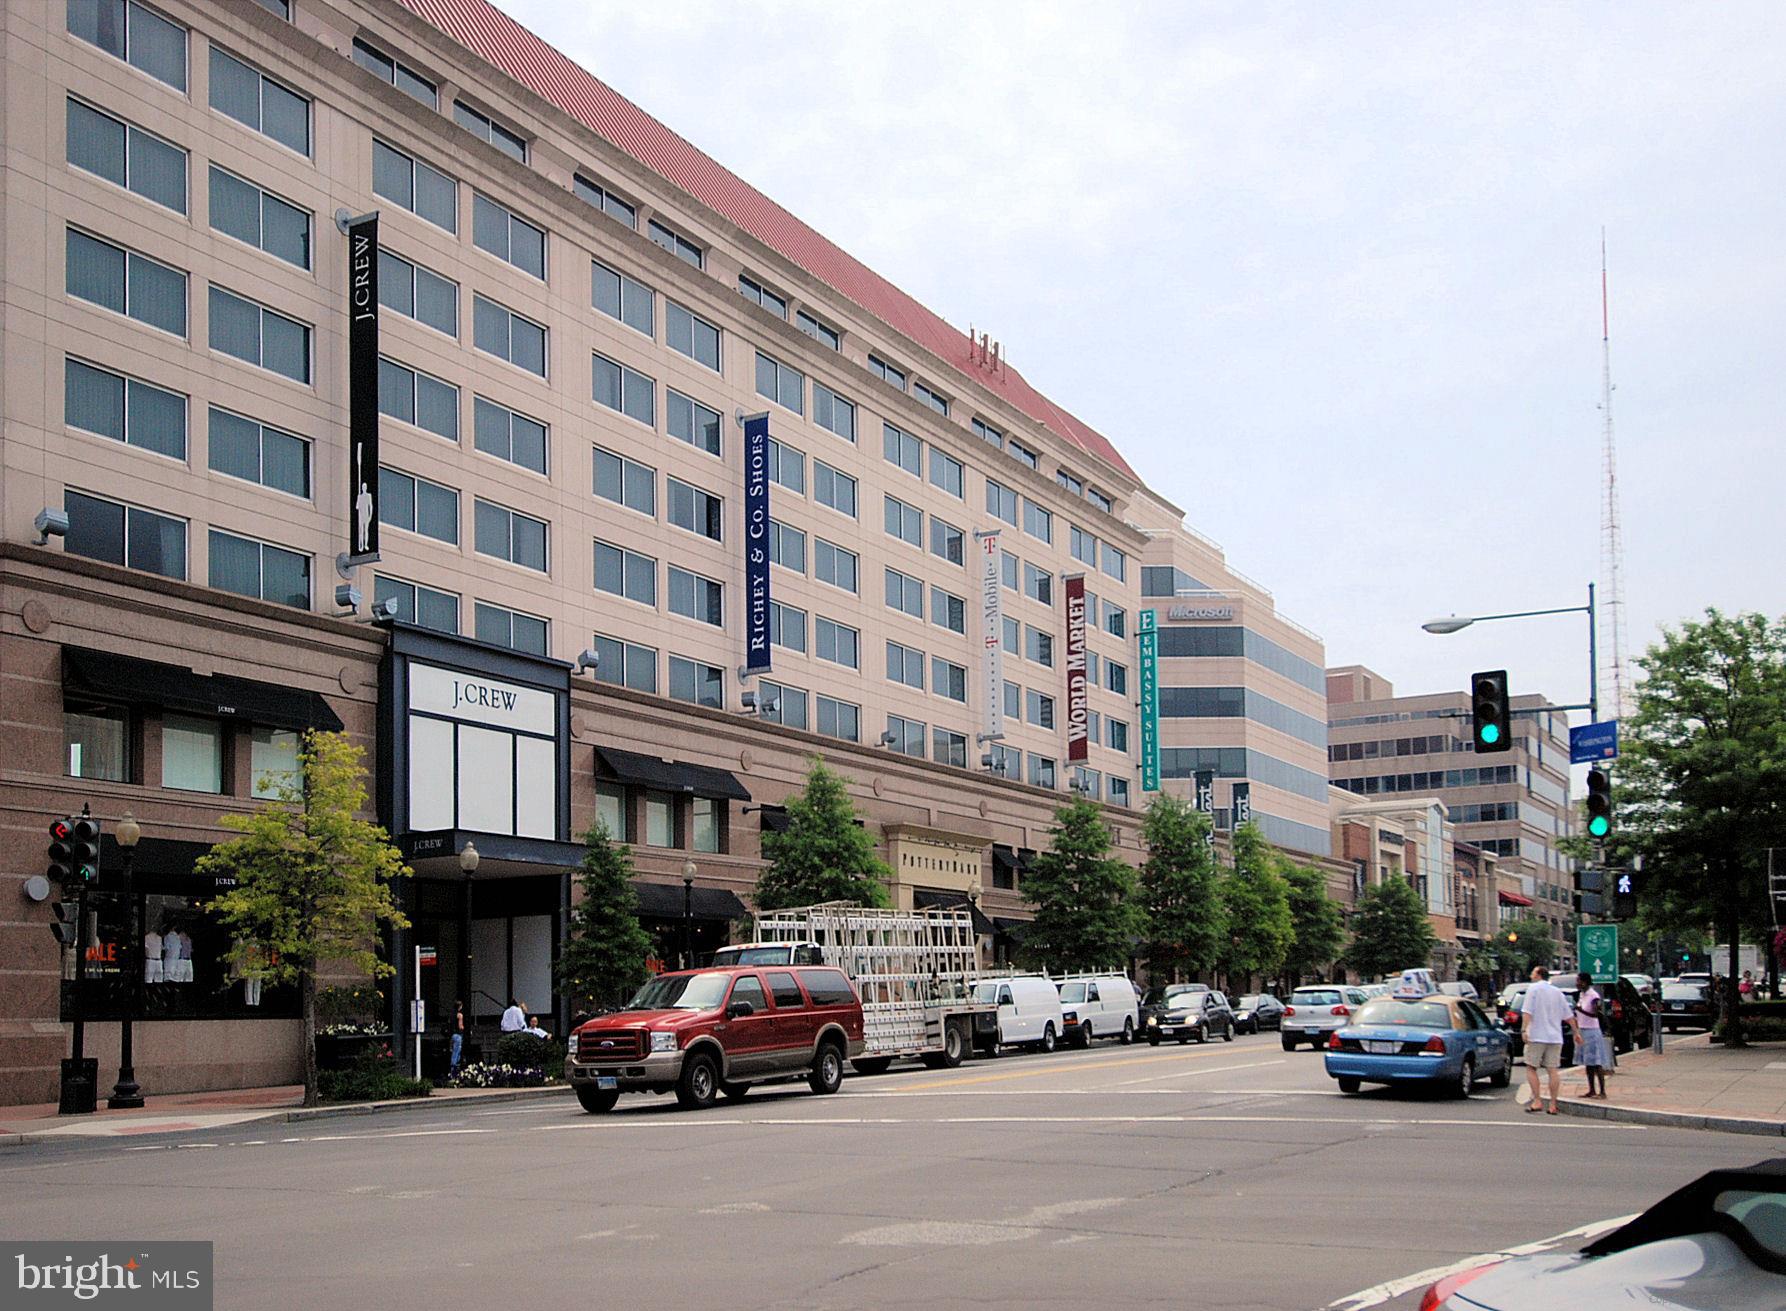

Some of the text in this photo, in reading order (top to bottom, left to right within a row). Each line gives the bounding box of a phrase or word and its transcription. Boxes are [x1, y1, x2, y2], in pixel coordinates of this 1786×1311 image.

[355, 235, 375, 322] J.CREW
[750, 433, 765, 651] RICHEY & CO. SHOES
[1067, 596, 1087, 743] WORLD MARKET
[1169, 604, 1233, 618] Microsoft
[452, 680, 518, 712] J.CREW
[1143, 635, 1154, 788] EMBASSY SUITES
